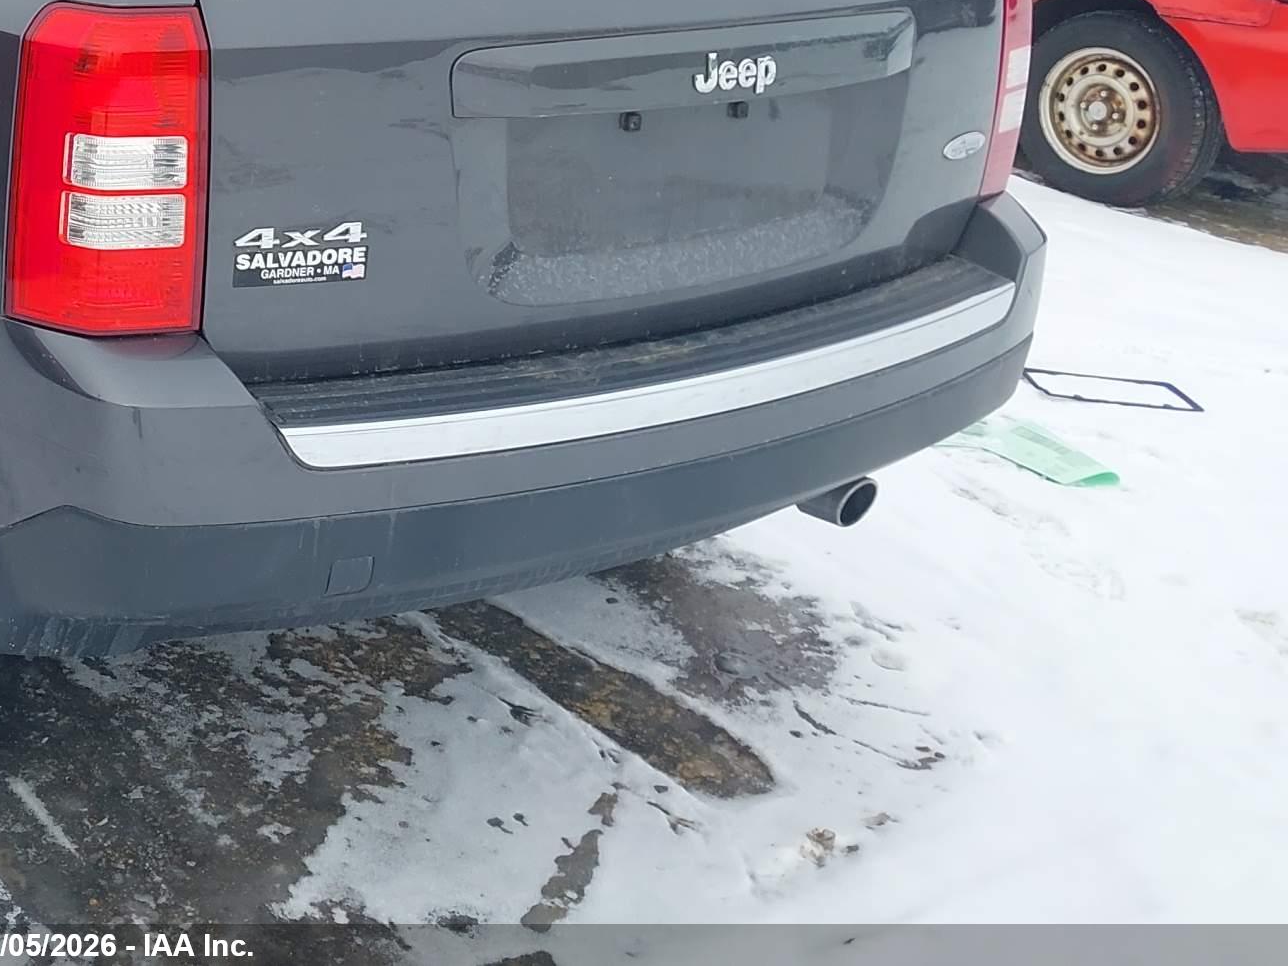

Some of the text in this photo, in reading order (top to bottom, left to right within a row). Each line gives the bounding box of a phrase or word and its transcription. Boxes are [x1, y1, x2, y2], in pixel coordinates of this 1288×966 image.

[695, 52, 777, 94] Jeep
[235, 221, 367, 249] 4x4
[235, 246, 366, 270] SALVADORE
[260, 266, 314, 280] GARDNER
[323, 264, 340, 275] MA
